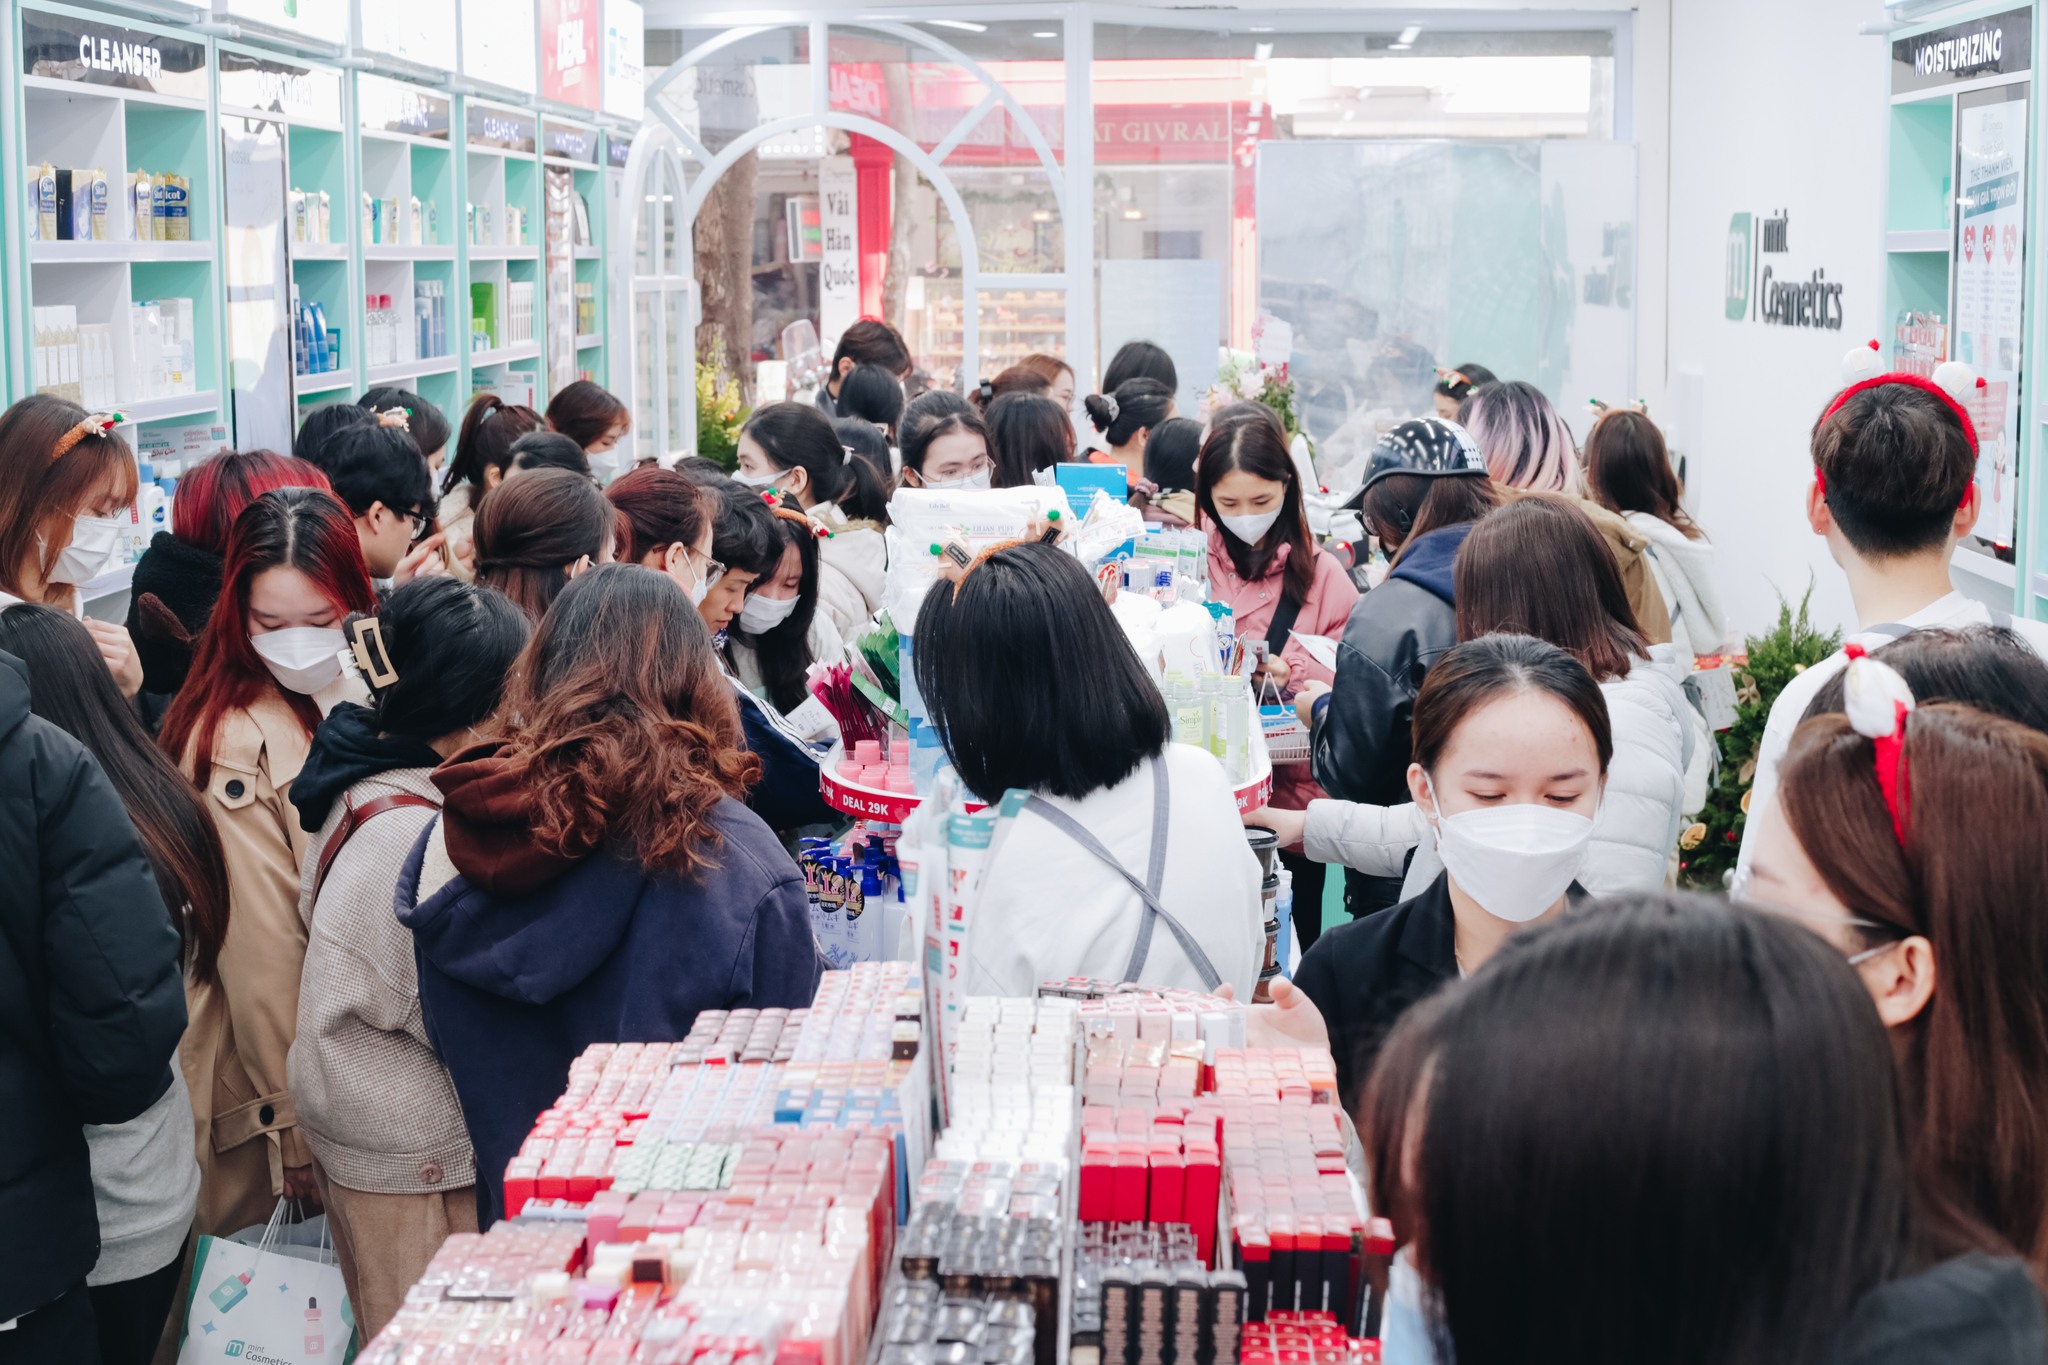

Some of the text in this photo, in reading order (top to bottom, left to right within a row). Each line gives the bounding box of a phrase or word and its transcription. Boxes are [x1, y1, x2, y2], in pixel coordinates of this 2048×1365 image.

[79, 34, 162, 79] CLEANSER
[1915, 28, 2003, 78] MOISTURIZING
[1121, 119, 1230, 144] GIVRAL
[826, 227, 851, 251] Hàn
[1763, 208, 1789, 253] mint
[823, 259, 855, 291] Quốc
[1761, 264, 1843, 331] Cosmetics
[1179, 714, 1203, 726] Simpl
[842, 794, 867, 812] DEAL
[868, 801, 890, 817] 29K
[1236, 796, 1249, 809] 9K
[247, 1344, 265, 1354] mint
